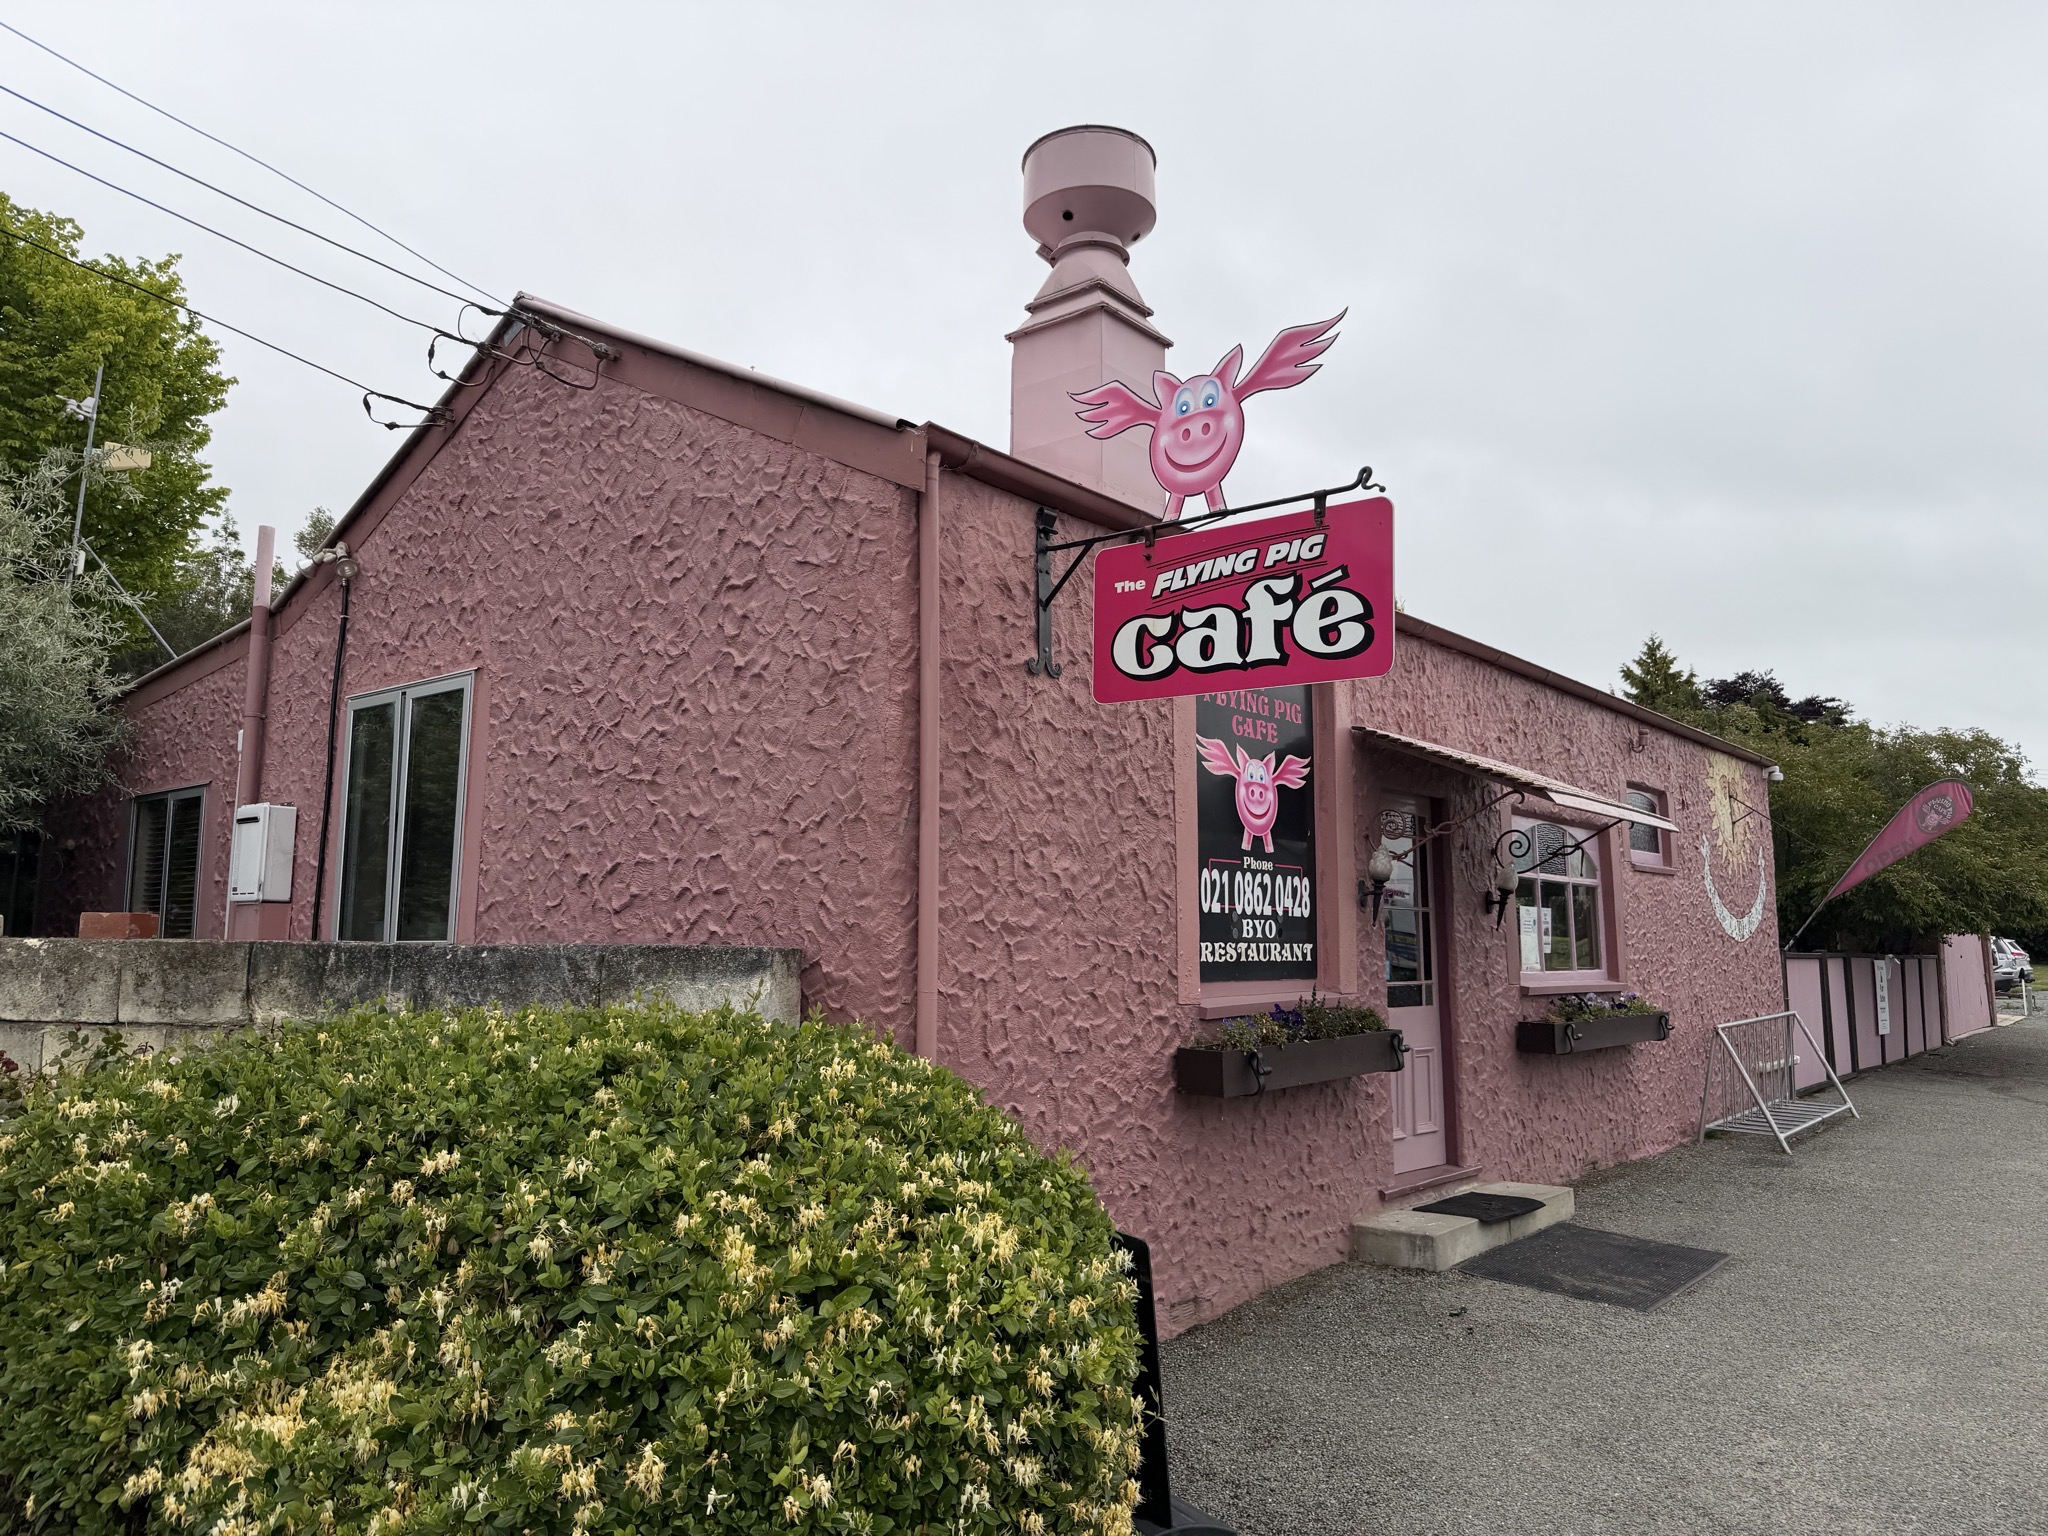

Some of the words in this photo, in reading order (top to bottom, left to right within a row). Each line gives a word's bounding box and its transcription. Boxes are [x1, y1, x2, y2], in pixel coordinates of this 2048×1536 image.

[1114, 579, 1146, 594] The
[1151, 548, 1259, 600] FLYING
[1263, 532, 1328, 568] PIG
[1111, 565, 1375, 682] café
[1274, 699, 1302, 724] PIG
[1231, 714, 1278, 743] CAFE
[1243, 856, 1274, 871] Phone
[1200, 867, 1229, 913] 021
[1234, 871, 1272, 916] 0862
[1275, 874, 1311, 918] 0428
[1241, 918, 1277, 939] BYO
[1200, 941, 1313, 962] RESTAURANT
